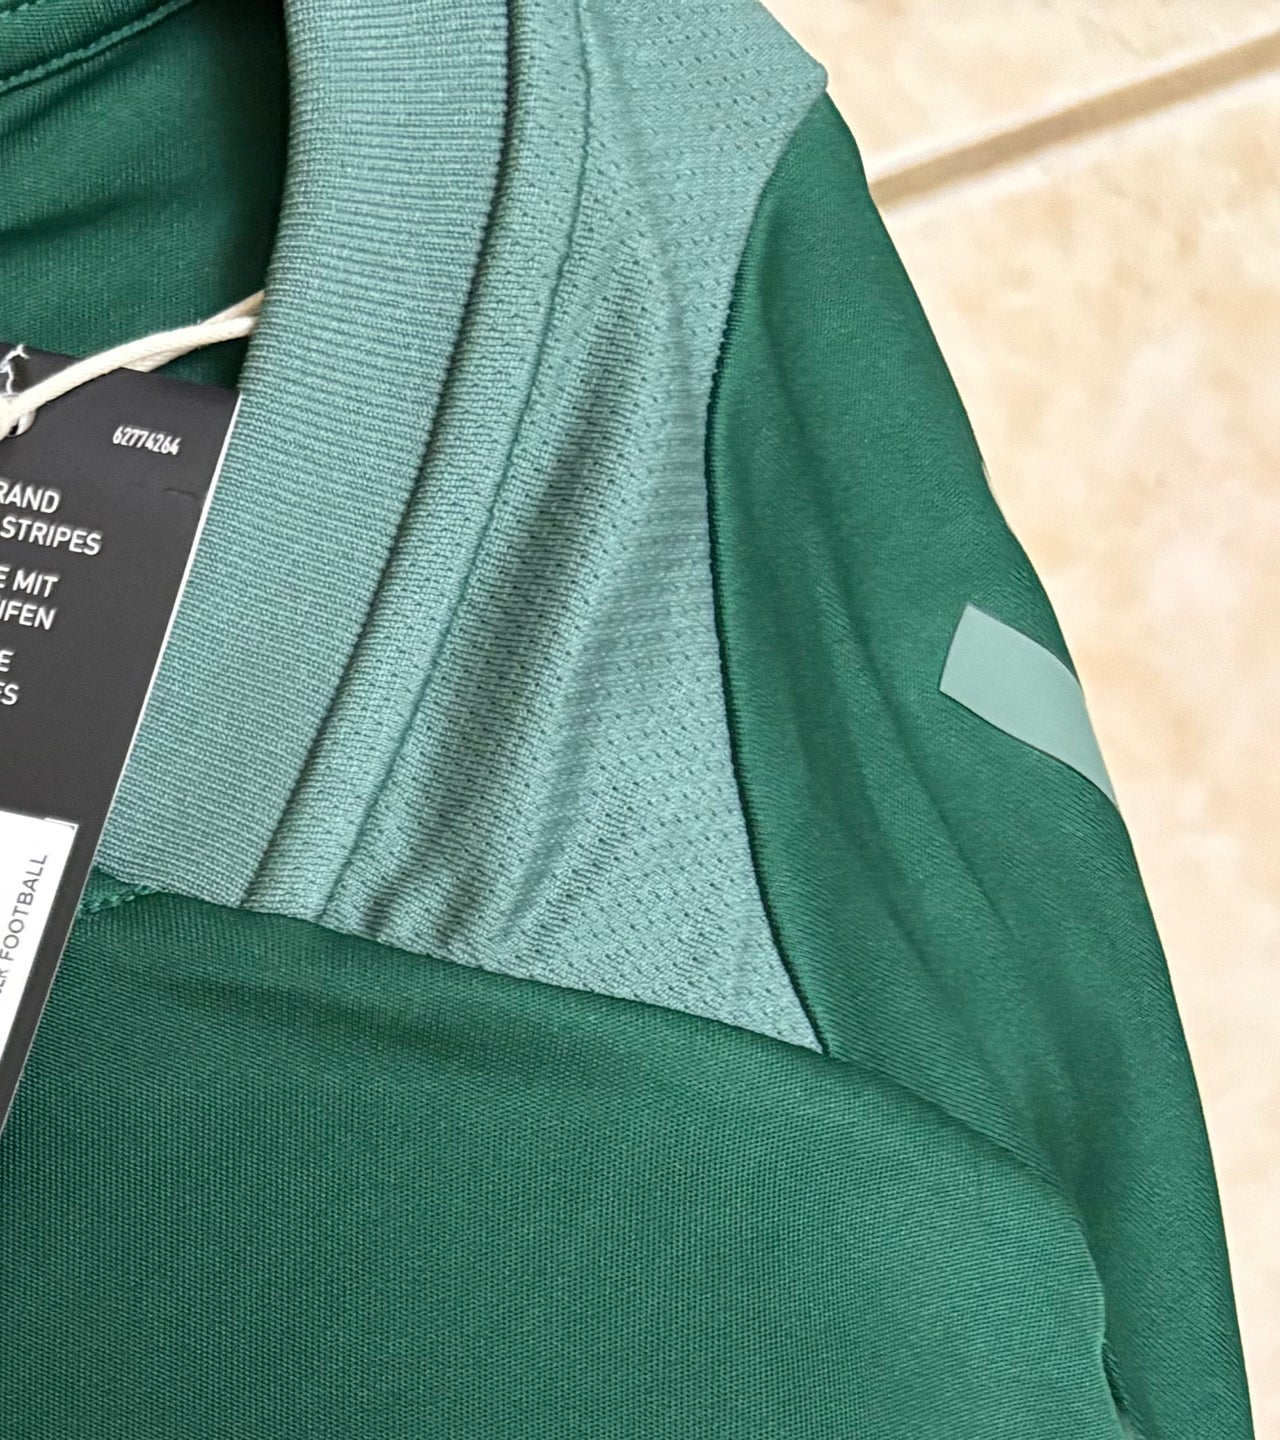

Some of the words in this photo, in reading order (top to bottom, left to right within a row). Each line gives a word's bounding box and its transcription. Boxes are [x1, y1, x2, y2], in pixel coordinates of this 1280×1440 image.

[112, 426, 181, 456] 62774264
[0, 515, 103, 556] STRIPES
[12, 569, 59, 598] MIT
